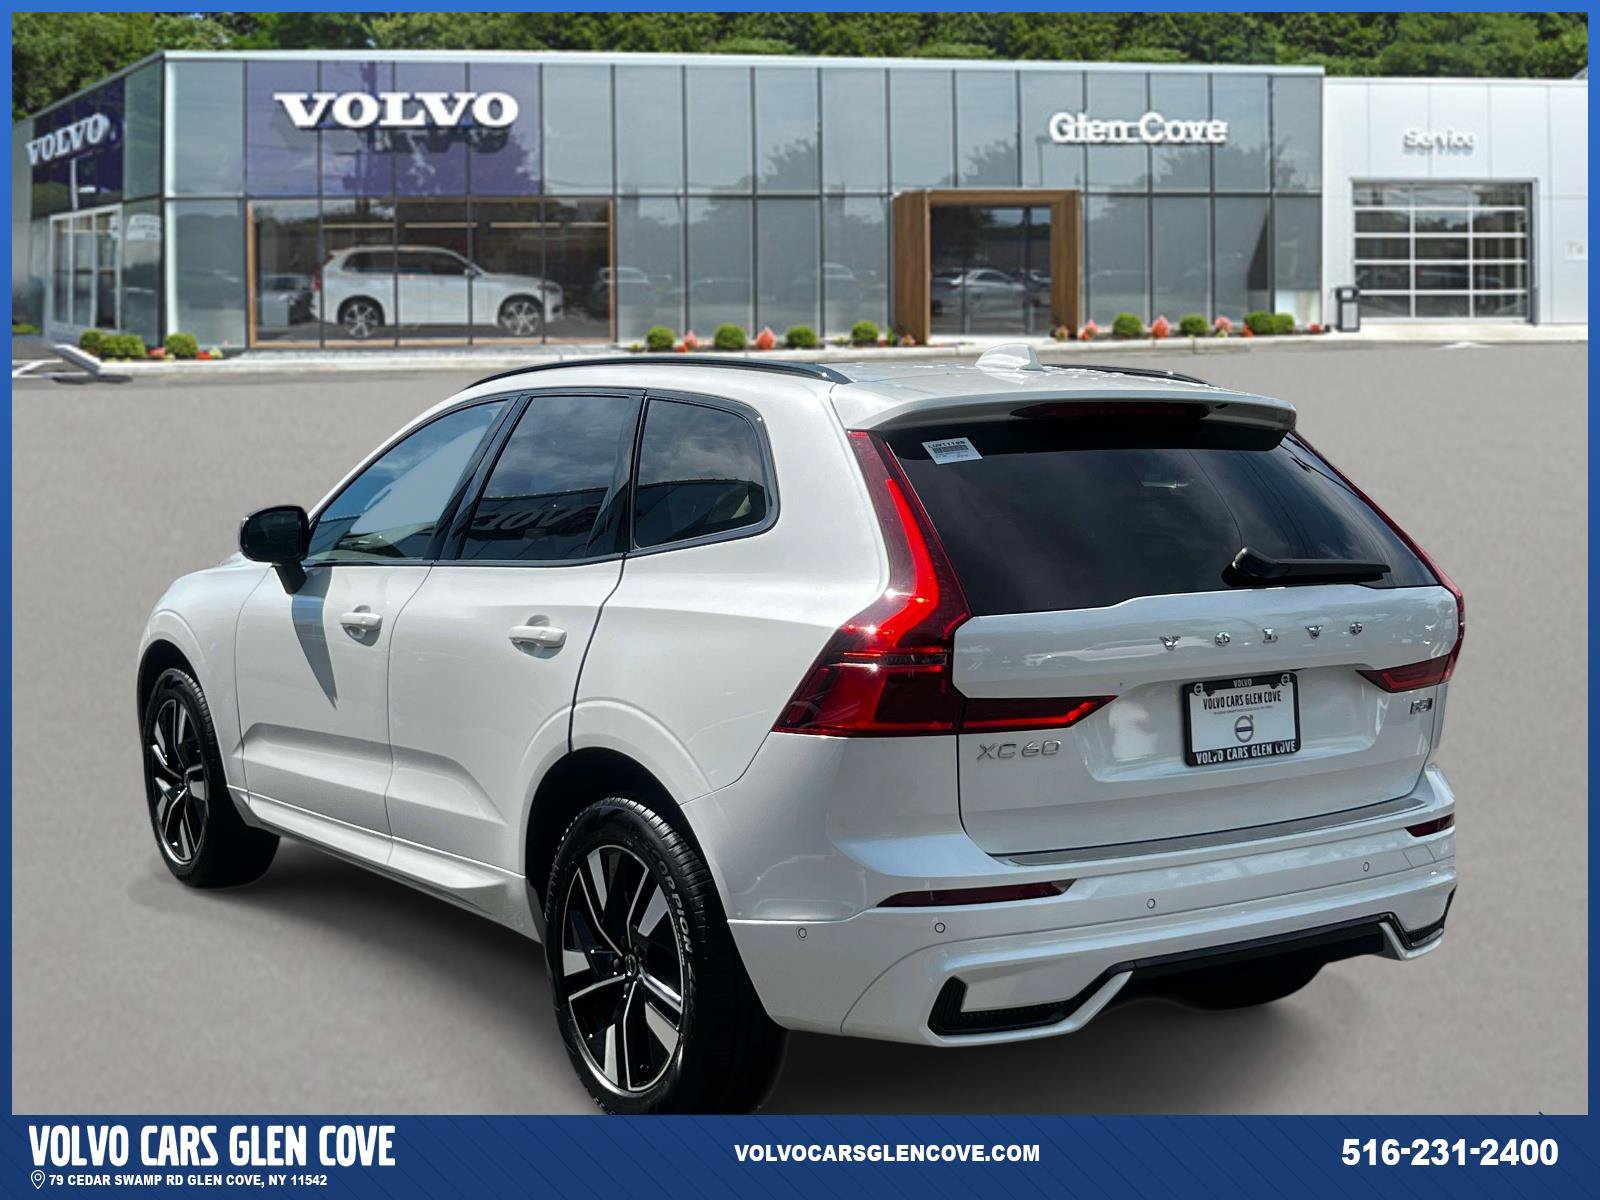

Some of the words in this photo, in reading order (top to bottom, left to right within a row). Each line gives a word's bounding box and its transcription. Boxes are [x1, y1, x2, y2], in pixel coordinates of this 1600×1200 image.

[275, 91, 519, 128] VOLVO
[25, 112, 110, 166] VOLVO
[1049, 112, 1128, 144] Glen
[1138, 112, 1228, 144] Cove
[1402, 128, 1476, 154] Service
[1160, 621, 1363, 651] VOLVO
[1233, 678, 1253, 688] VOLVO
[1203, 697, 1225, 711] VOLVO
[1226, 694, 1244, 707] CARS
[1245, 692, 1263, 705] GLEN
[1264, 690, 1282, 703] COVE
[1196, 749, 1224, 764] VOLVO
[1226, 747, 1249, 760] CARS
[1251, 743, 1273, 757] GLEN
